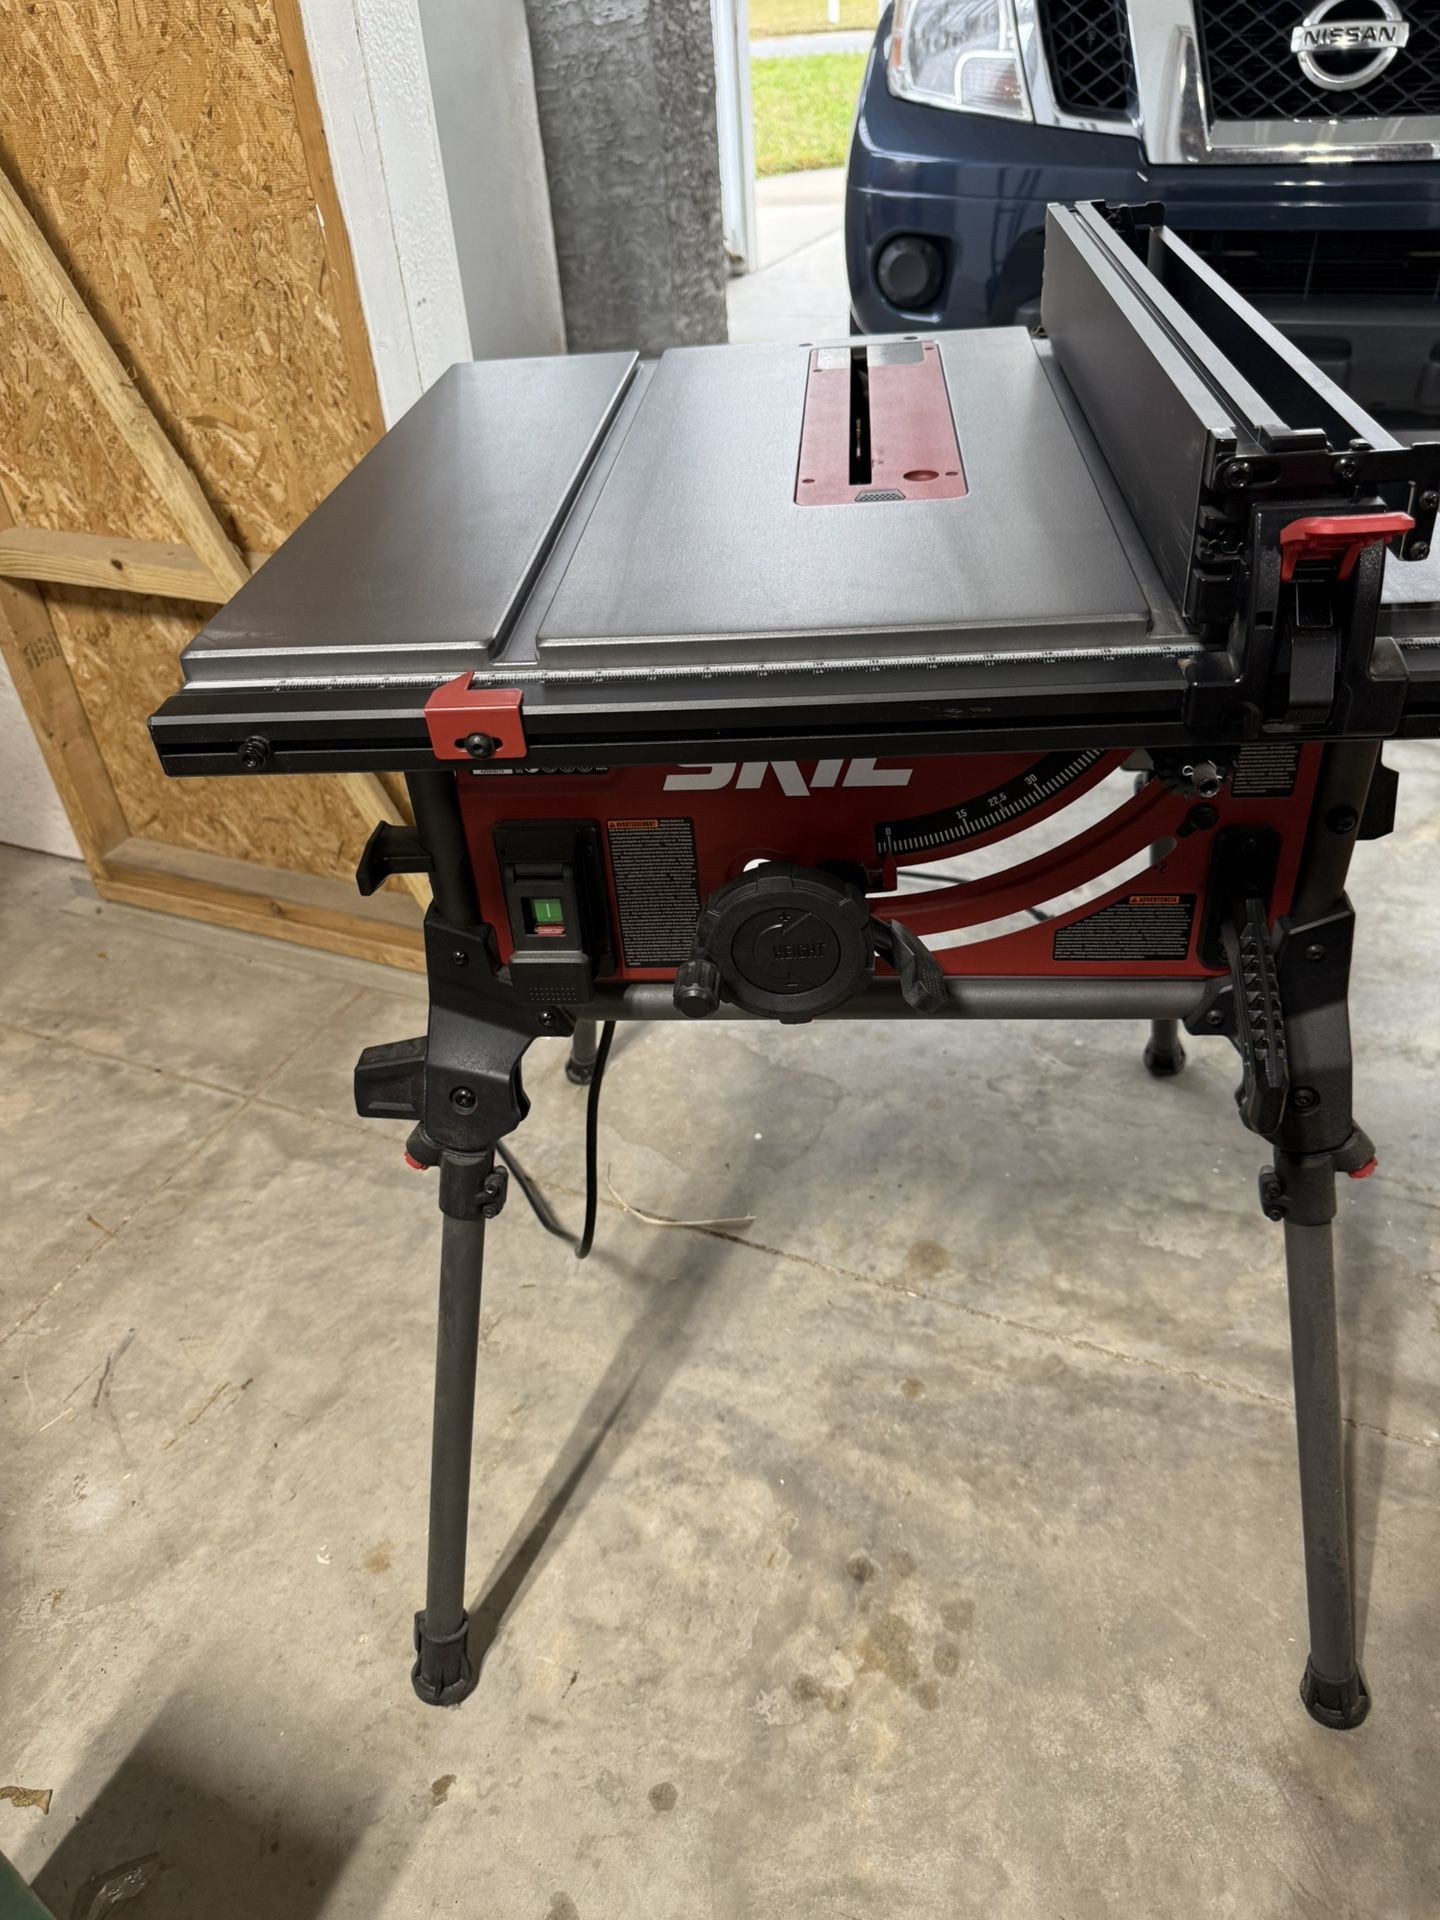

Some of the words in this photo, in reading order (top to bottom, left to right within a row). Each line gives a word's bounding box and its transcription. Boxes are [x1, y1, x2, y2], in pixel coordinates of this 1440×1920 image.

[1304, 26, 1396, 46] NISSAN
[1024, 774, 1038, 785] 30
[987, 792, 1007, 807] 22.5
[955, 808, 968, 819] 15
[885, 827, 891, 836] 0
[1139, 896, 1178, 904] ADVERTENCIA
[774, 942, 826, 959] HEIGHT
